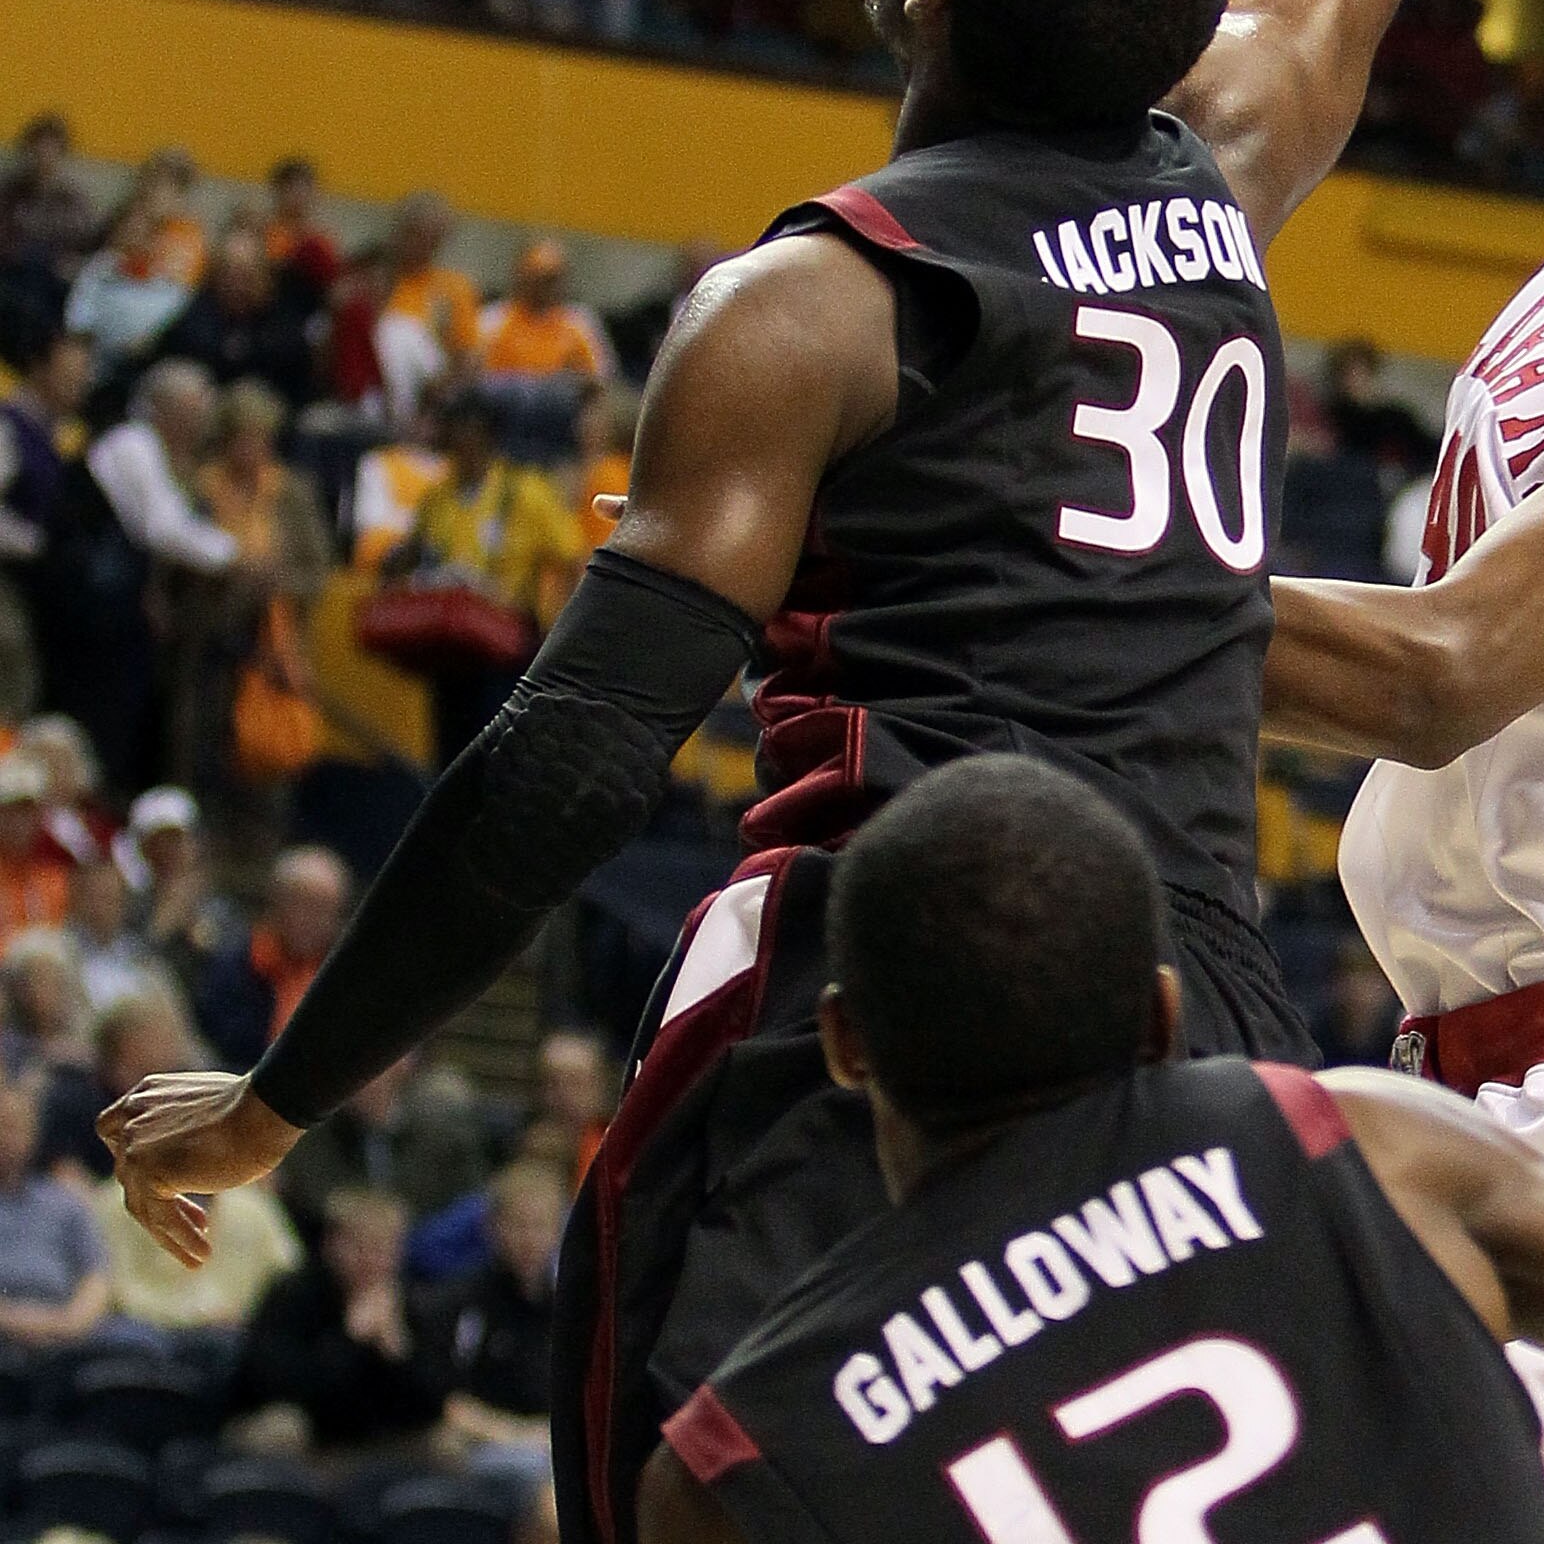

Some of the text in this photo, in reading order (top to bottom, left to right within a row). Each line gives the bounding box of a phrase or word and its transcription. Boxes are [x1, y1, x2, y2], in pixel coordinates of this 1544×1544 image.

[1033, 197, 1267, 295] JACKSON
[1057, 304, 1266, 571] 30
[833, 1147, 1265, 1445] GALLOWAY
